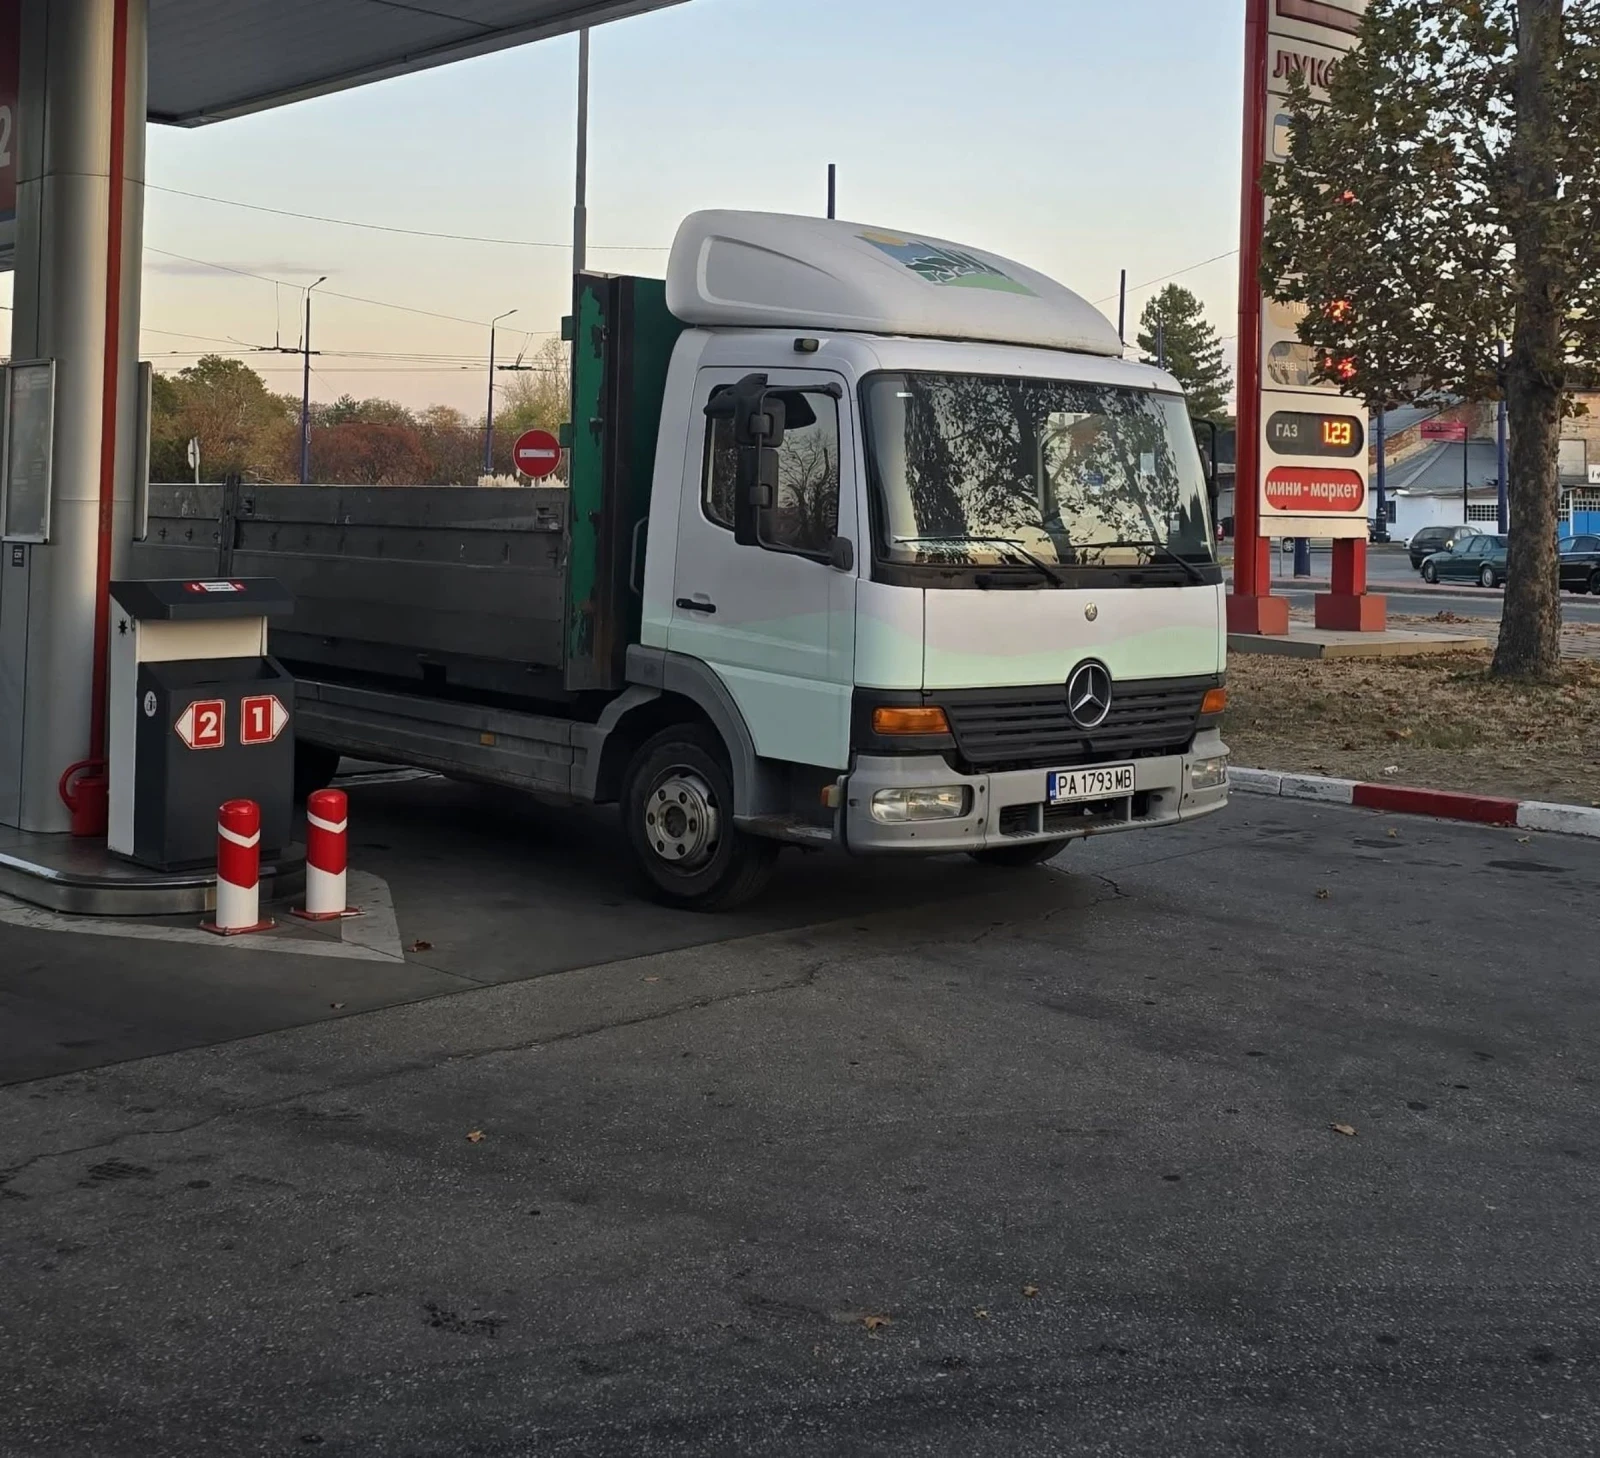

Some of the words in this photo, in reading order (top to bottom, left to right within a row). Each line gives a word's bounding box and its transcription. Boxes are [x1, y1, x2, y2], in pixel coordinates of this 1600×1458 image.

[1275, 423, 1298, 438] ГАЗ
[1323, 421, 1351, 445] 1.23
[198, 711, 218, 738] 2
[252, 706, 264, 733] 1
[1058, 774, 1078, 796] PA
[1081, 771, 1113, 794] 1793
[1115, 769, 1132, 790] MB
